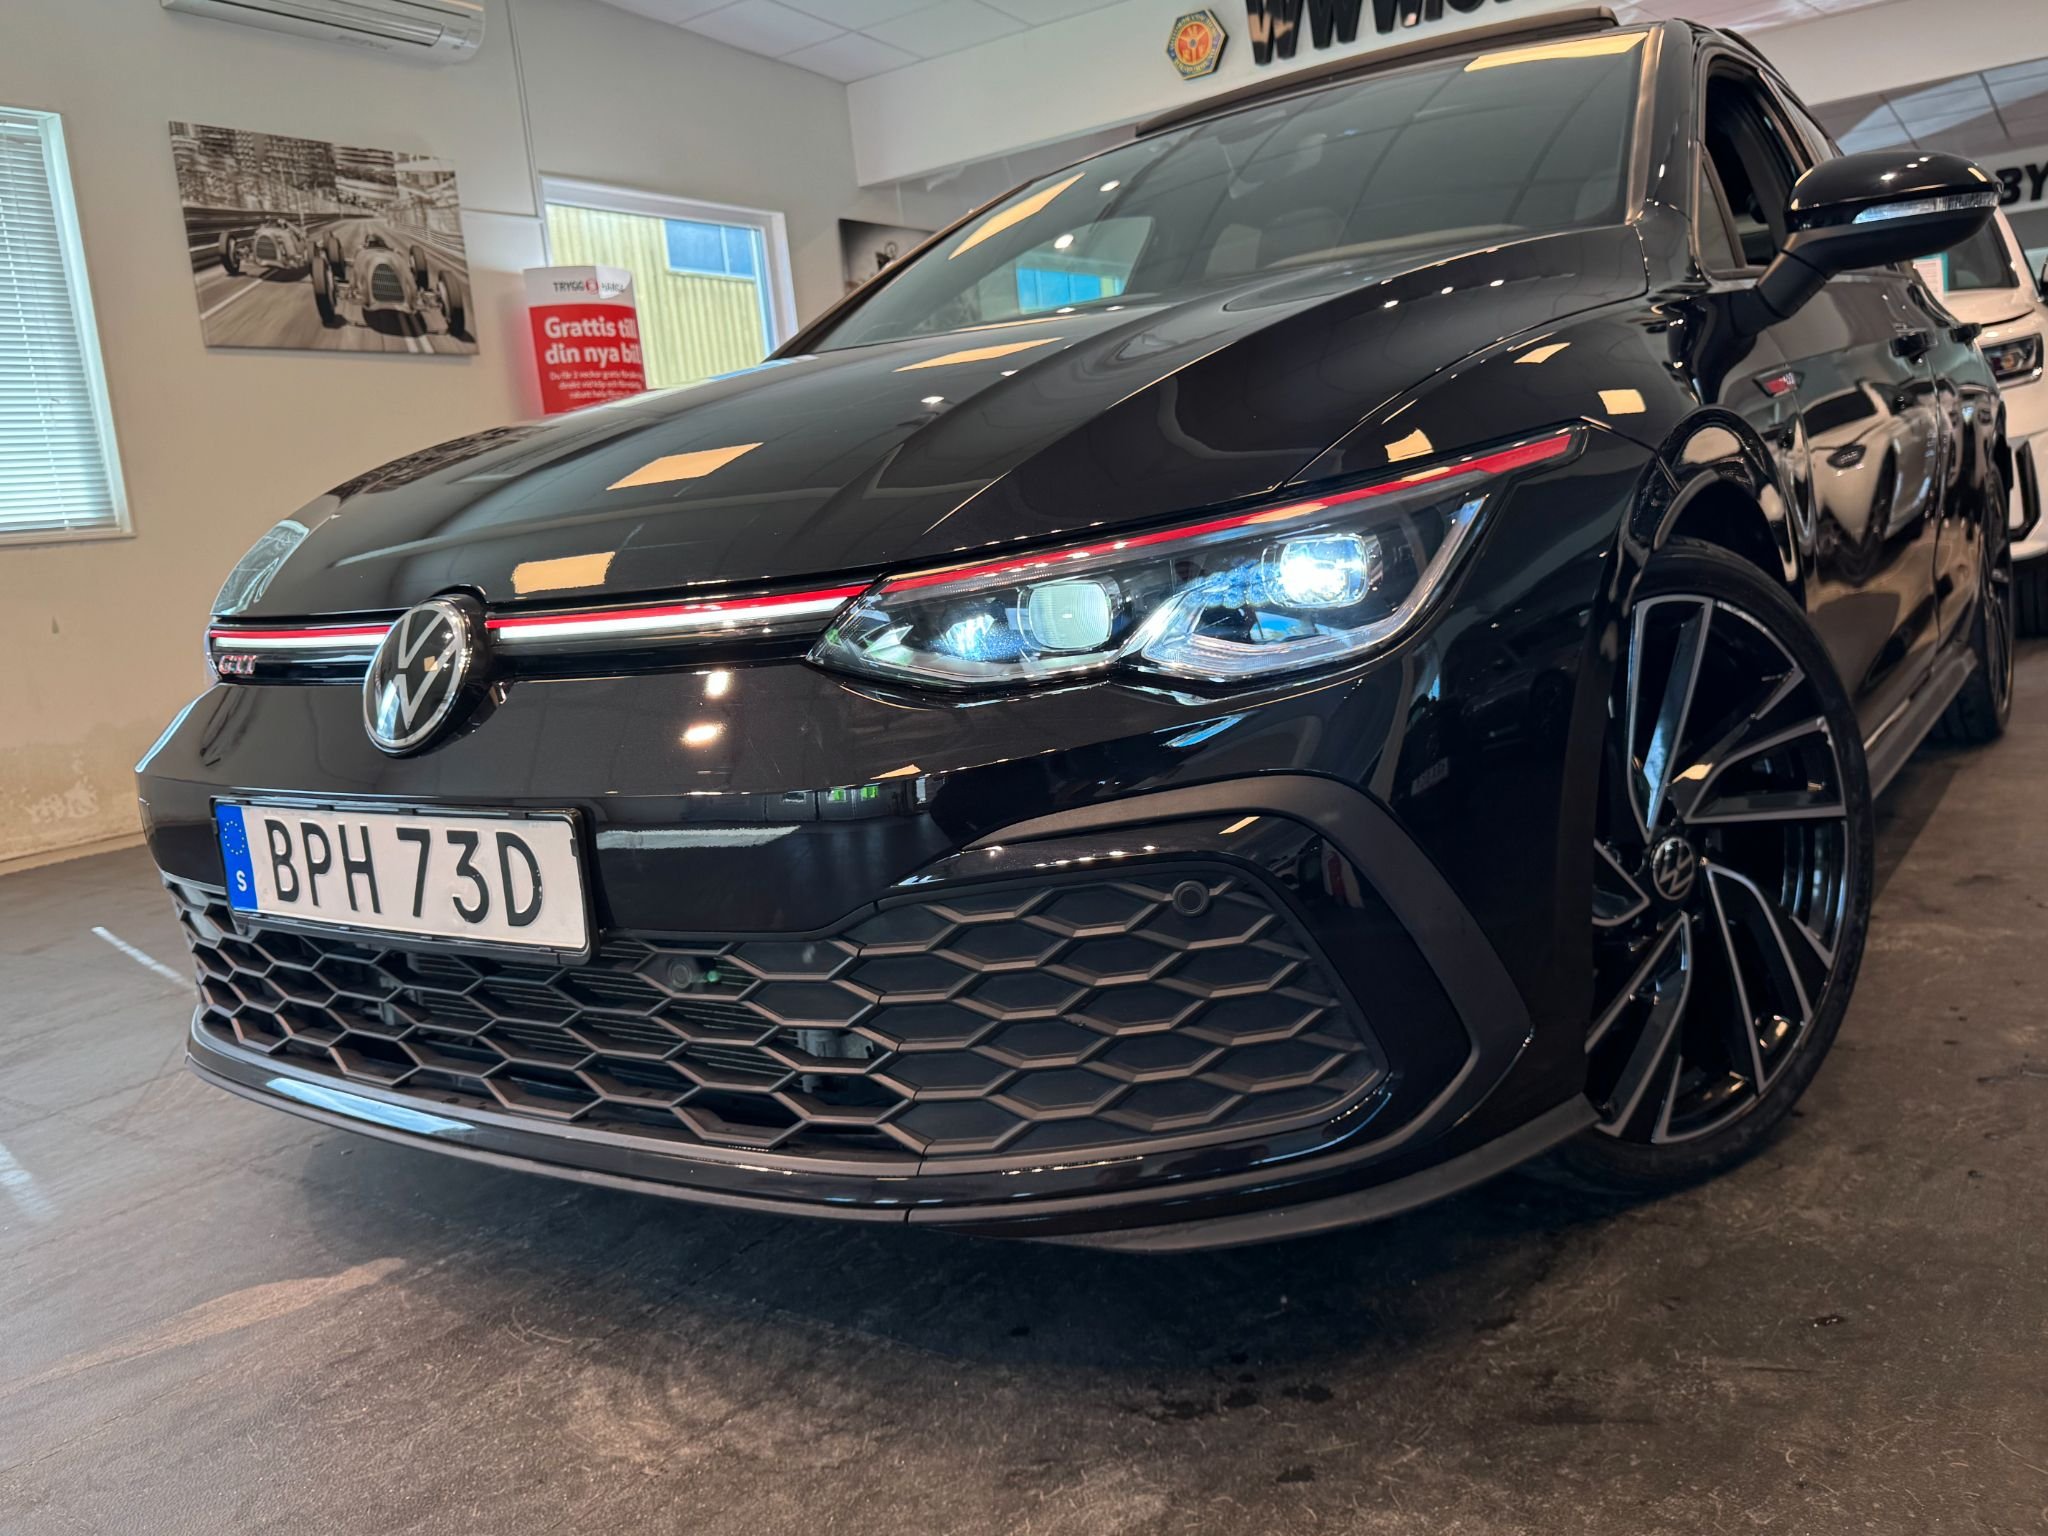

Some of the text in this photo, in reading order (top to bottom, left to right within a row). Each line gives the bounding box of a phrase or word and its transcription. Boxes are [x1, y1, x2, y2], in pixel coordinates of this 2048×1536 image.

[553, 280, 585, 293] TRYGG
[544, 316, 638, 339] Grattis till
[545, 342, 581, 365] din
[584, 346, 620, 369] nya
[218, 654, 257, 675] GTI
[235, 818, 543, 927] S BPH 73D
